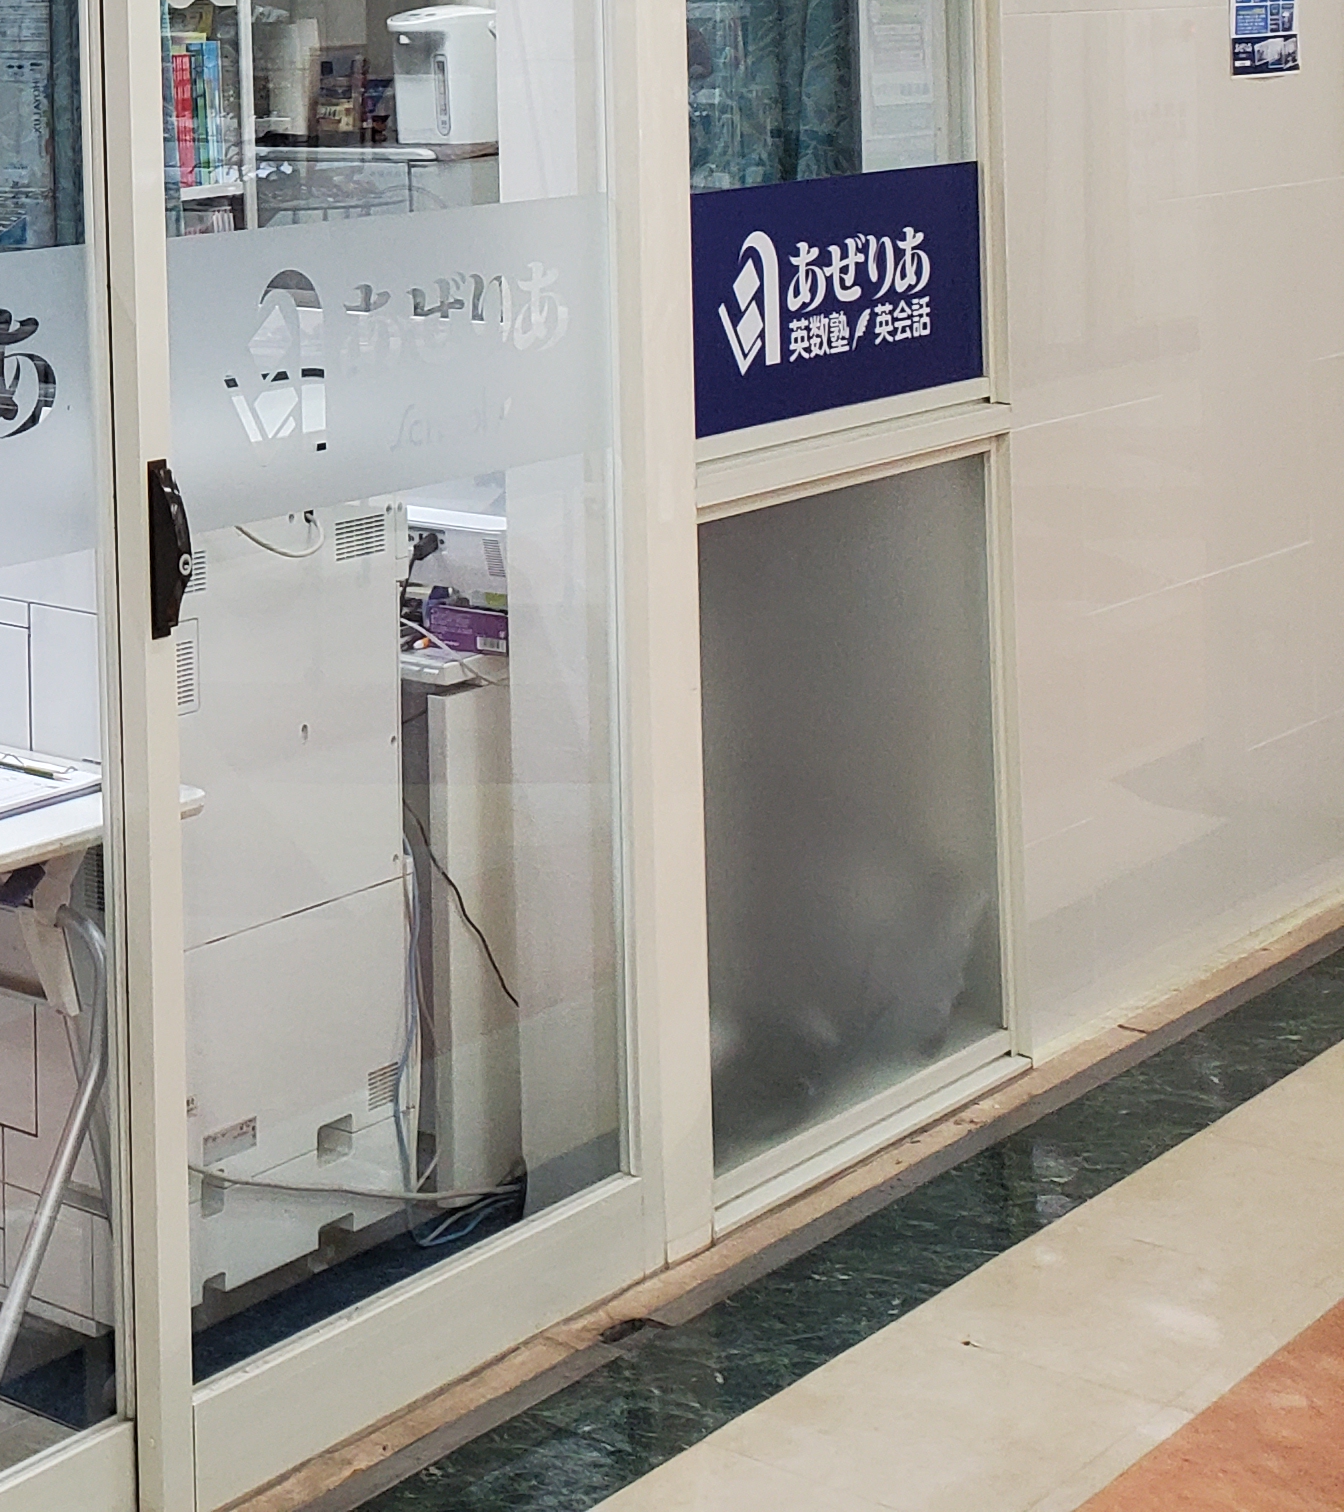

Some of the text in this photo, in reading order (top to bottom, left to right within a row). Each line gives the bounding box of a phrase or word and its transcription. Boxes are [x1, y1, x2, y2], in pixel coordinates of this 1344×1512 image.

[787, 226, 931, 313] あぜりあ
[789, 296, 931, 363] 英数塾 英会話
